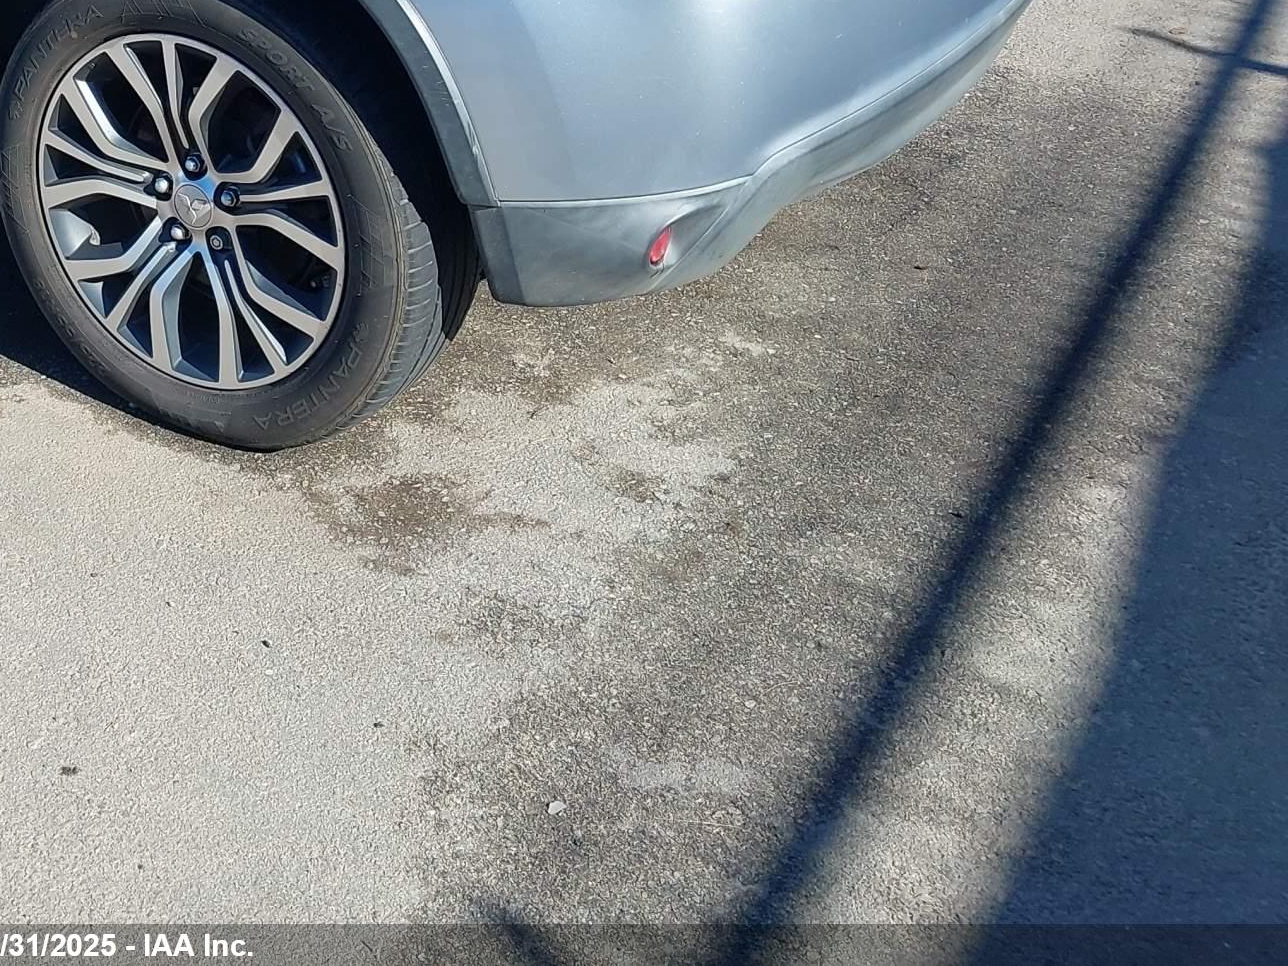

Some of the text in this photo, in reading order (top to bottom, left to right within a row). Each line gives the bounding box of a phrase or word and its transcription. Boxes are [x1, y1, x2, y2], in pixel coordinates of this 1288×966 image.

[237, 26, 354, 152] SPORT A/S
[252, 342, 363, 431] PANTERA
